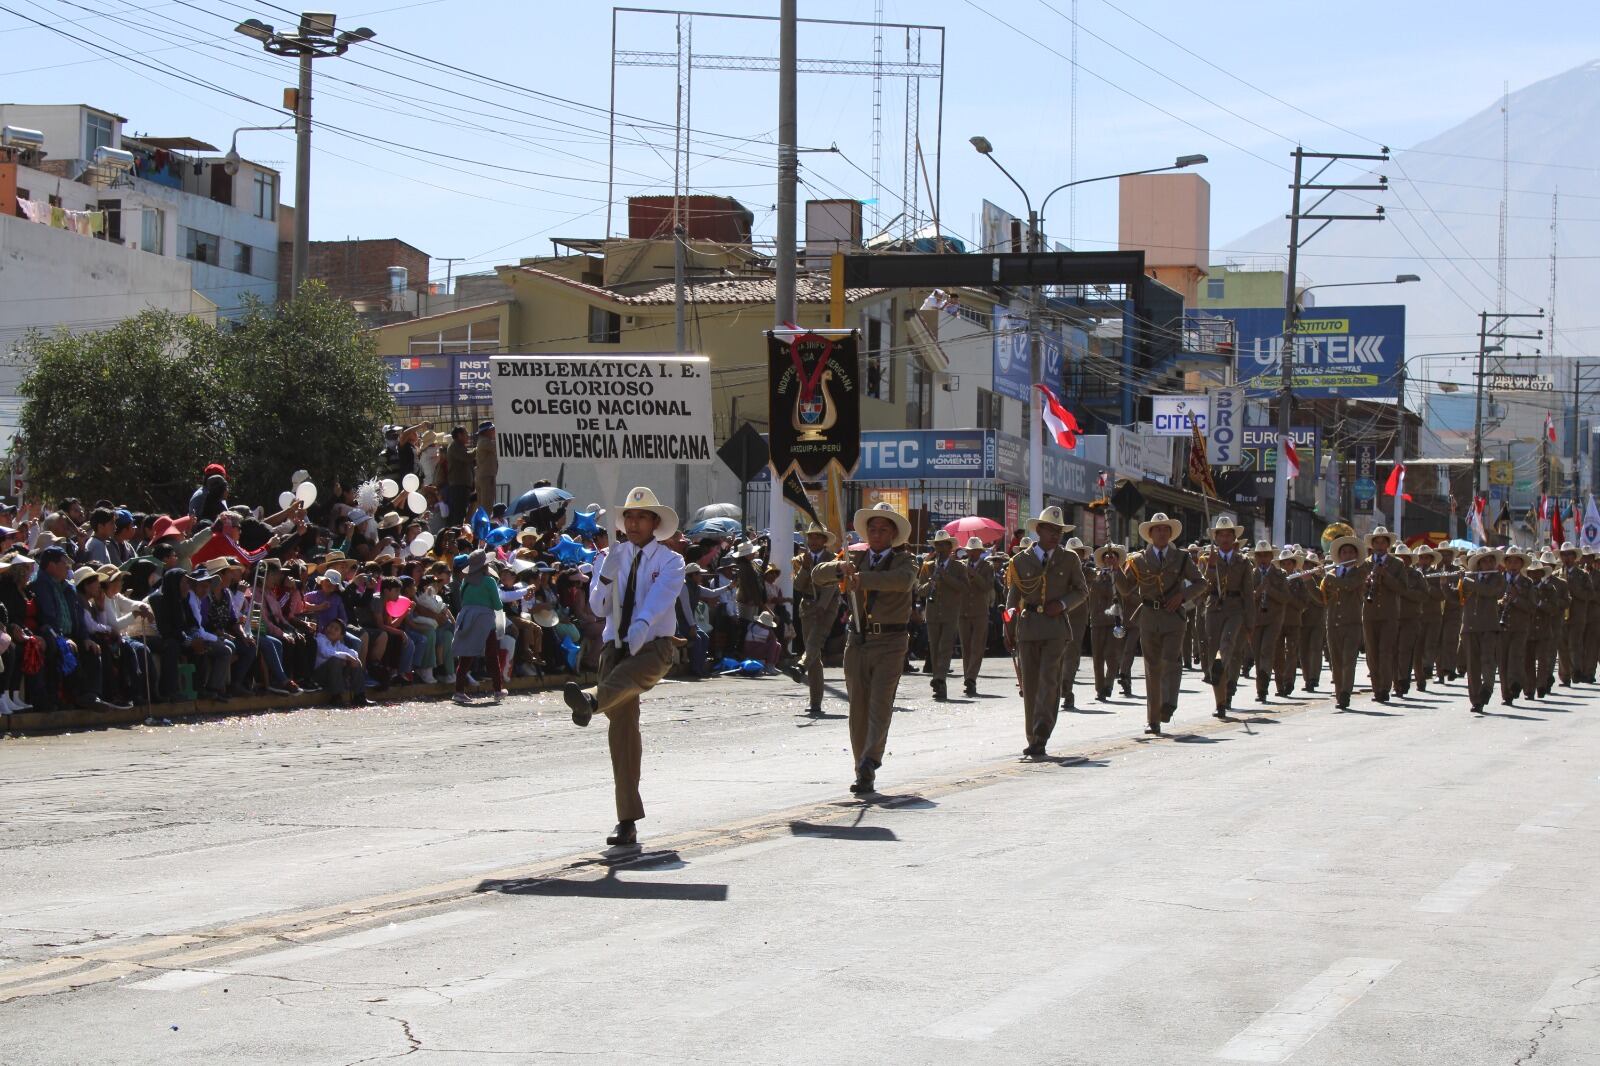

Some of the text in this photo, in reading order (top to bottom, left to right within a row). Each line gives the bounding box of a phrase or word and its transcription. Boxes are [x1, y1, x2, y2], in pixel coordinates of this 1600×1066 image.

[497, 361, 653, 377] EMBLEMÁTICA
[546, 380, 654, 396] GLORIOSO
[512, 398, 691, 416] COLEGIO NACIONAL
[577, 418, 628, 430] DE LA
[1155, 414, 1206, 430] CITEC
[1214, 392, 1234, 462] BROS
[498, 433, 710, 459] INDEPENDENCIA AMERICANA
[1063, 461, 1086, 494] CITEC
